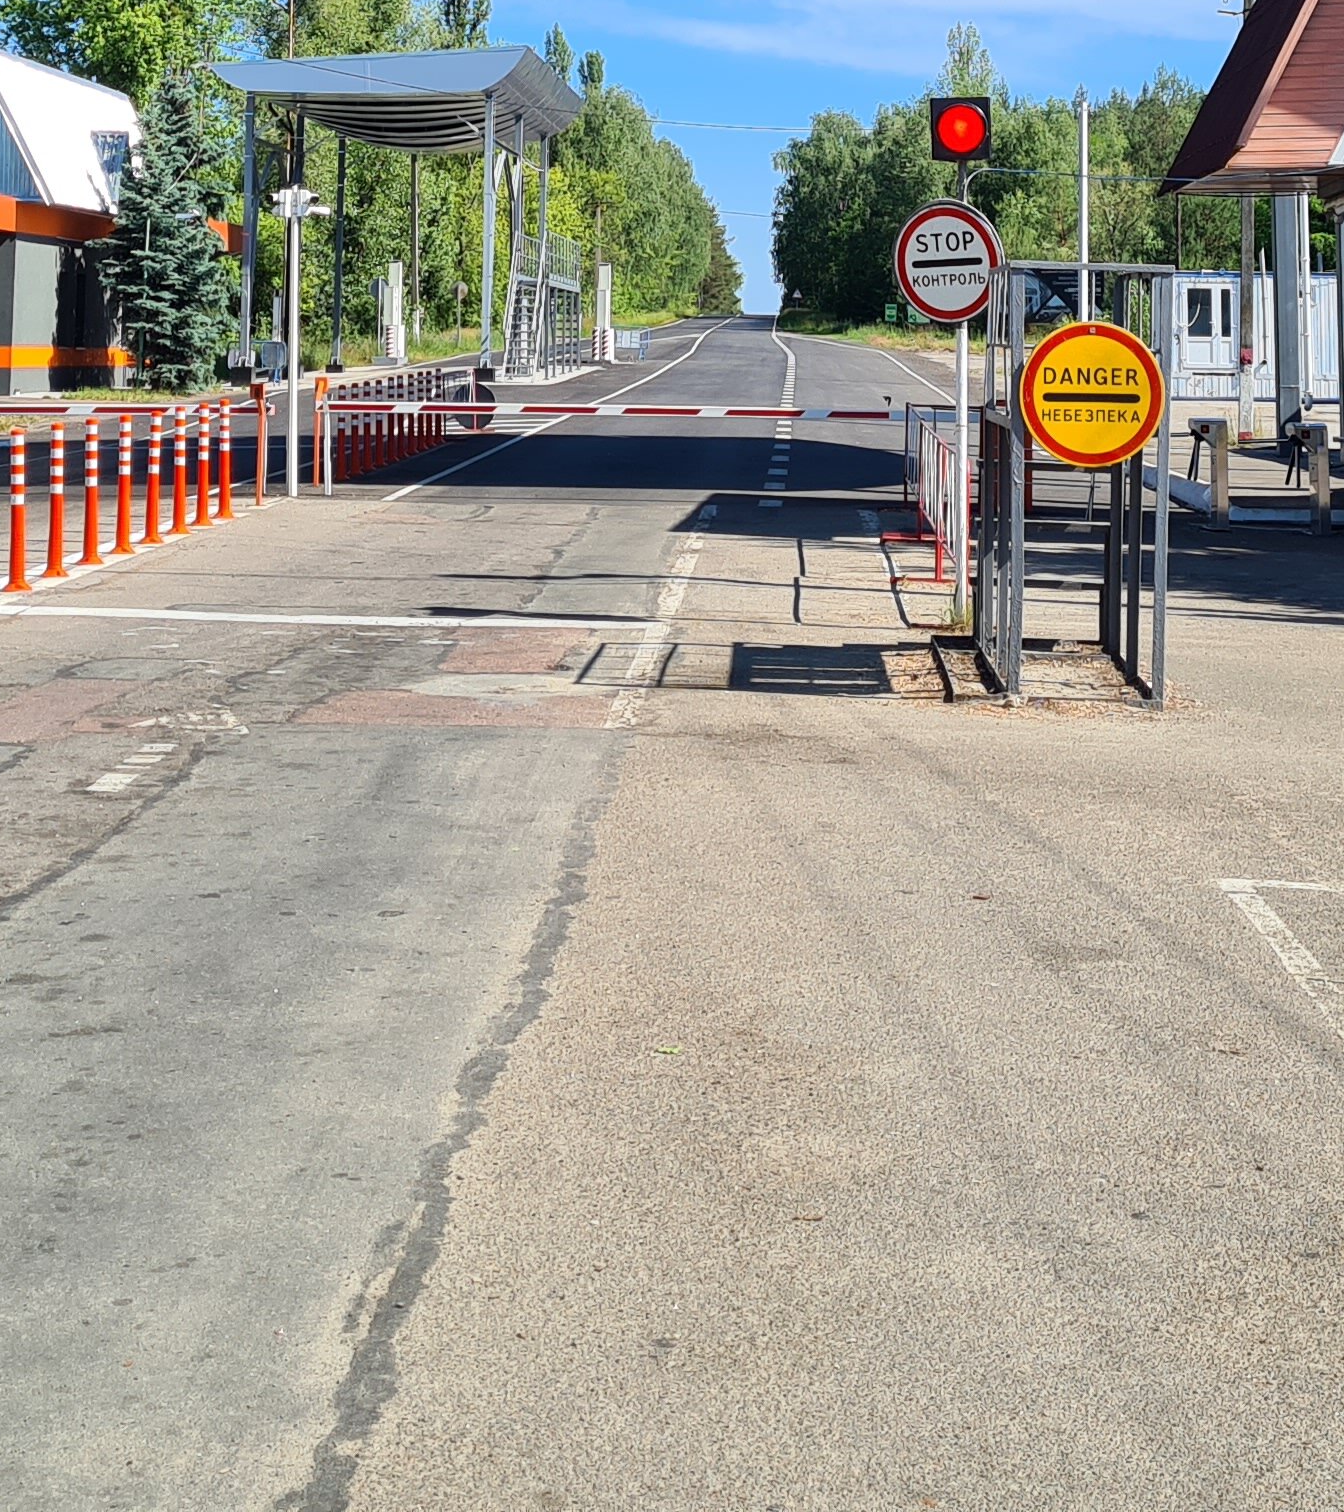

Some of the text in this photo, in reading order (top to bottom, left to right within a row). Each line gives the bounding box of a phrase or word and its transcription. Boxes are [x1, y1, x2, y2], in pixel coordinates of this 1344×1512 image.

[915, 230, 975, 253] STOP
[912, 272, 986, 288] КОНТРОЛЬ
[1043, 367, 1139, 386] DANGER
[1041, 408, 1141, 423] НЕБЕЗПЕКА
